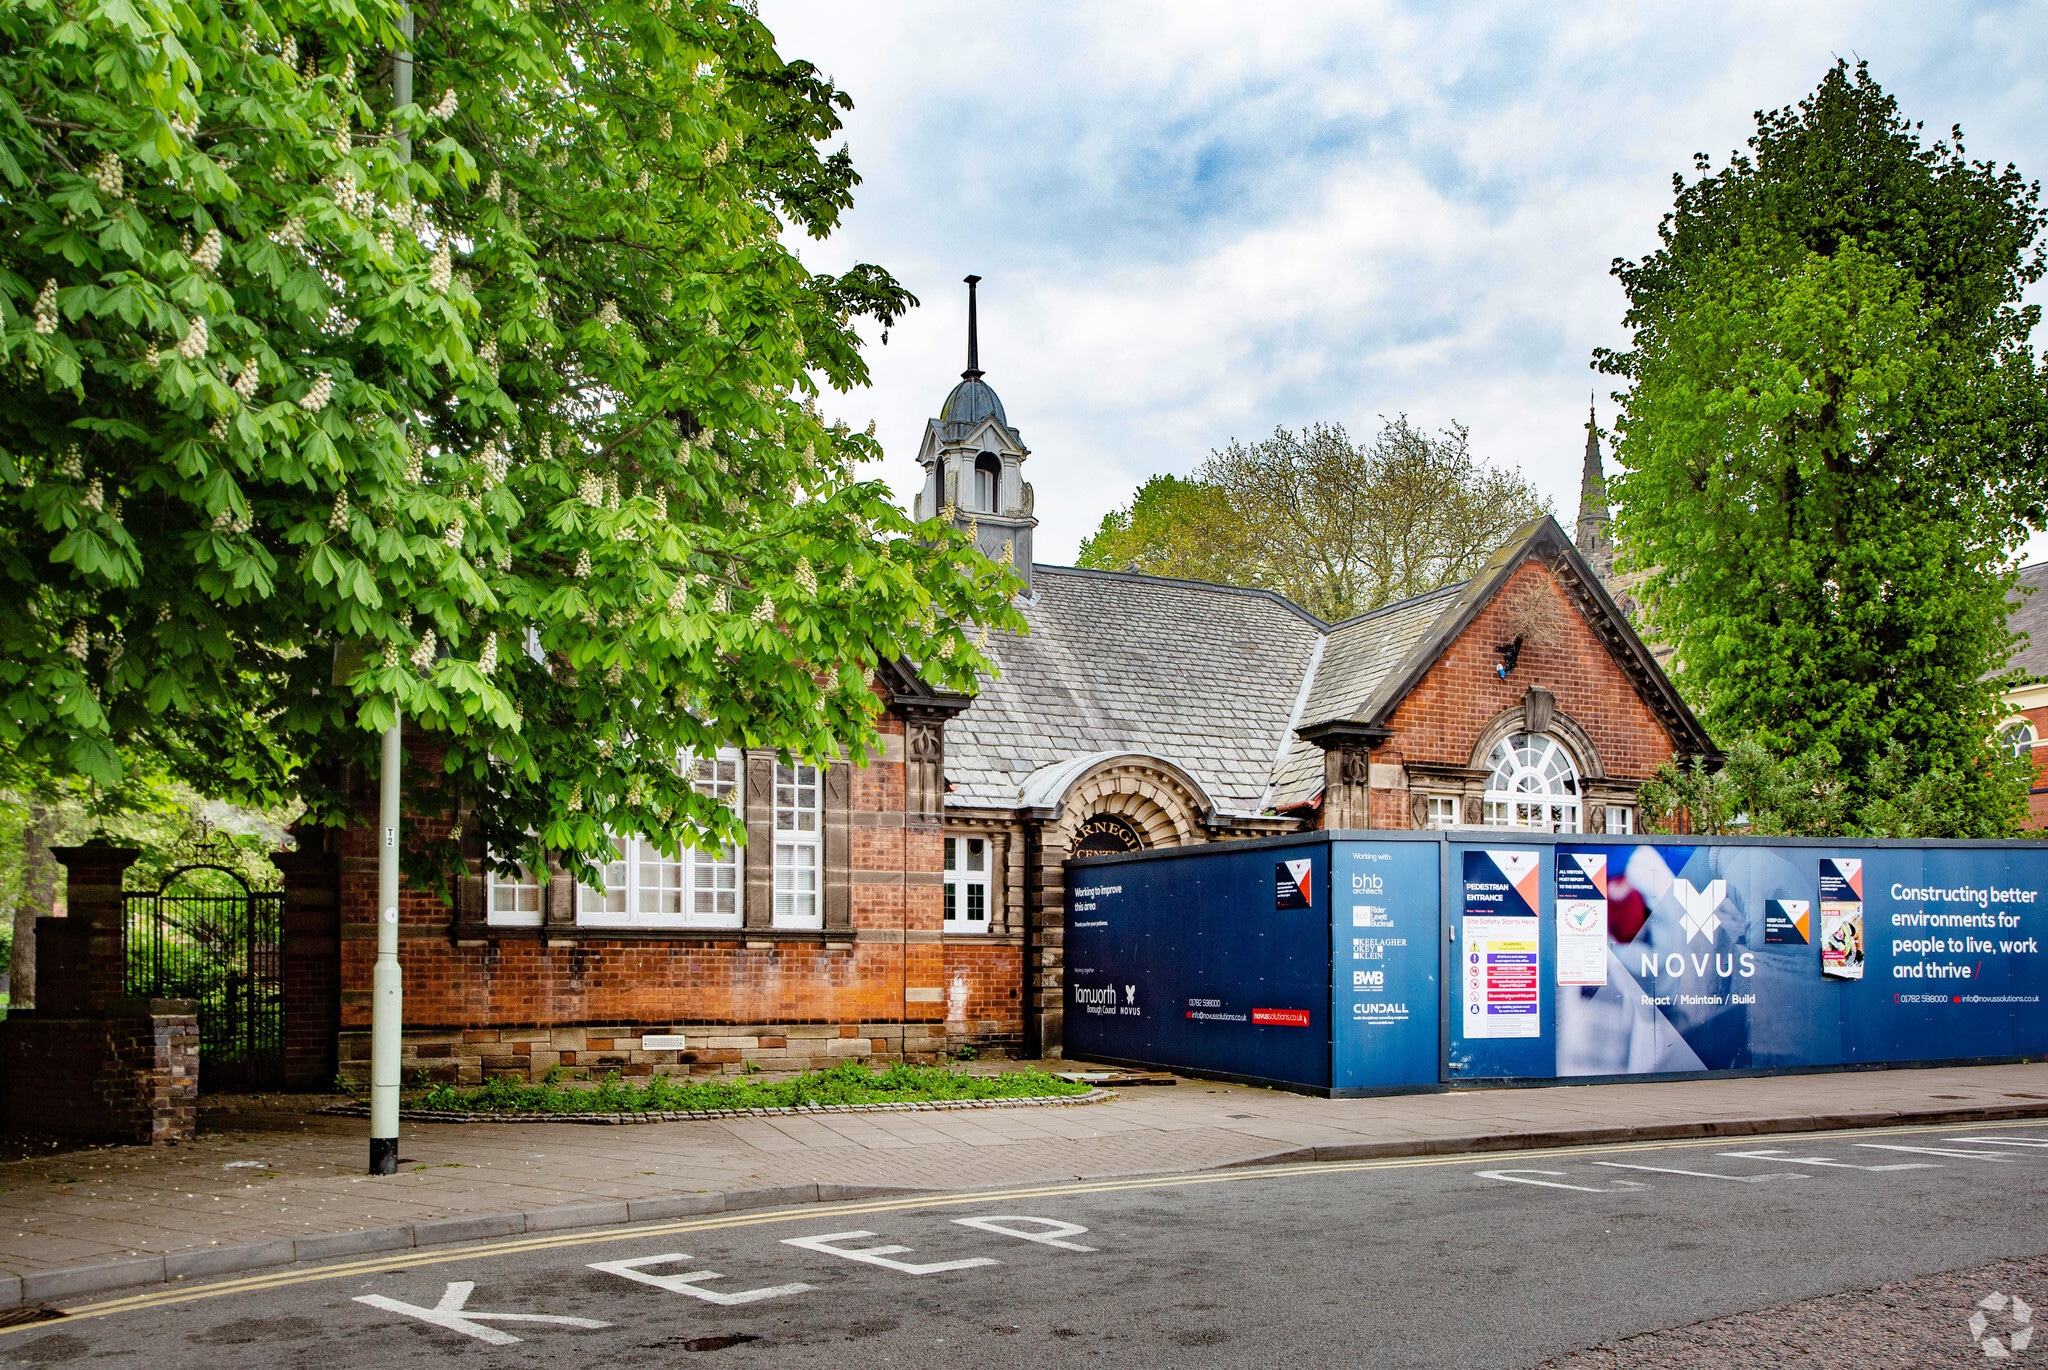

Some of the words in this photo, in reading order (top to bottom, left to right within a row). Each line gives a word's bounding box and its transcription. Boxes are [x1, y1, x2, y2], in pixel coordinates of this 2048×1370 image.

[1352, 852, 1377, 862] Working
[1378, 853, 1392, 861] with:
[1353, 873, 1383, 888] bhb
[1075, 886, 1094, 899] Working
[1095, 886, 1100, 895] to
[1101, 885, 1122, 897] improve
[1891, 883, 1988, 908] Constructing
[1990, 886, 2037, 903] better
[1075, 903, 1083, 912] this
[1084, 902, 1095, 911] area
[1371, 920, 1394, 928] Bucknall
[1892, 909, 1996, 927] environments
[1998, 911, 2020, 928] for
[1360, 938, 1407, 946] KEELAGHER
[1893, 935, 1945, 957] people
[1948, 937, 1963, 953] to
[1966, 936, 1996, 955] live,
[1999, 937, 2038, 954] work
[1353, 945, 1375, 953] OKEY
[1642, 952, 1755, 978] NOVUS
[1893, 961, 1923, 978] and
[1926, 962, 1971, 979] thrive
[1353, 971, 1383, 985] BWB
[1074, 983, 1116, 1005] Tamworth
[1641, 995, 1670, 1005] React
[1681, 994, 1722, 1005] Maintain
[1732, 994, 1755, 1004] Build
[1901, 995, 1920, 1003] 01782
[1922, 995, 1948, 1003] 598000
[1962, 995, 2040, 1004] info@novussolutions.co.uk
[1087, 1005, 1102, 1016] Borough
[1102, 1005, 1116, 1015] Council
[1120, 1007, 1140, 1016] NOVUS
[1353, 1003, 1408, 1014] CUNDALL
[1192, 1011, 1247, 1022] info@novussolutions.co.uk
[1254, 1012, 1303, 1022] novussolutions.co.uk
[351, 1215, 1101, 1346] KEEP
